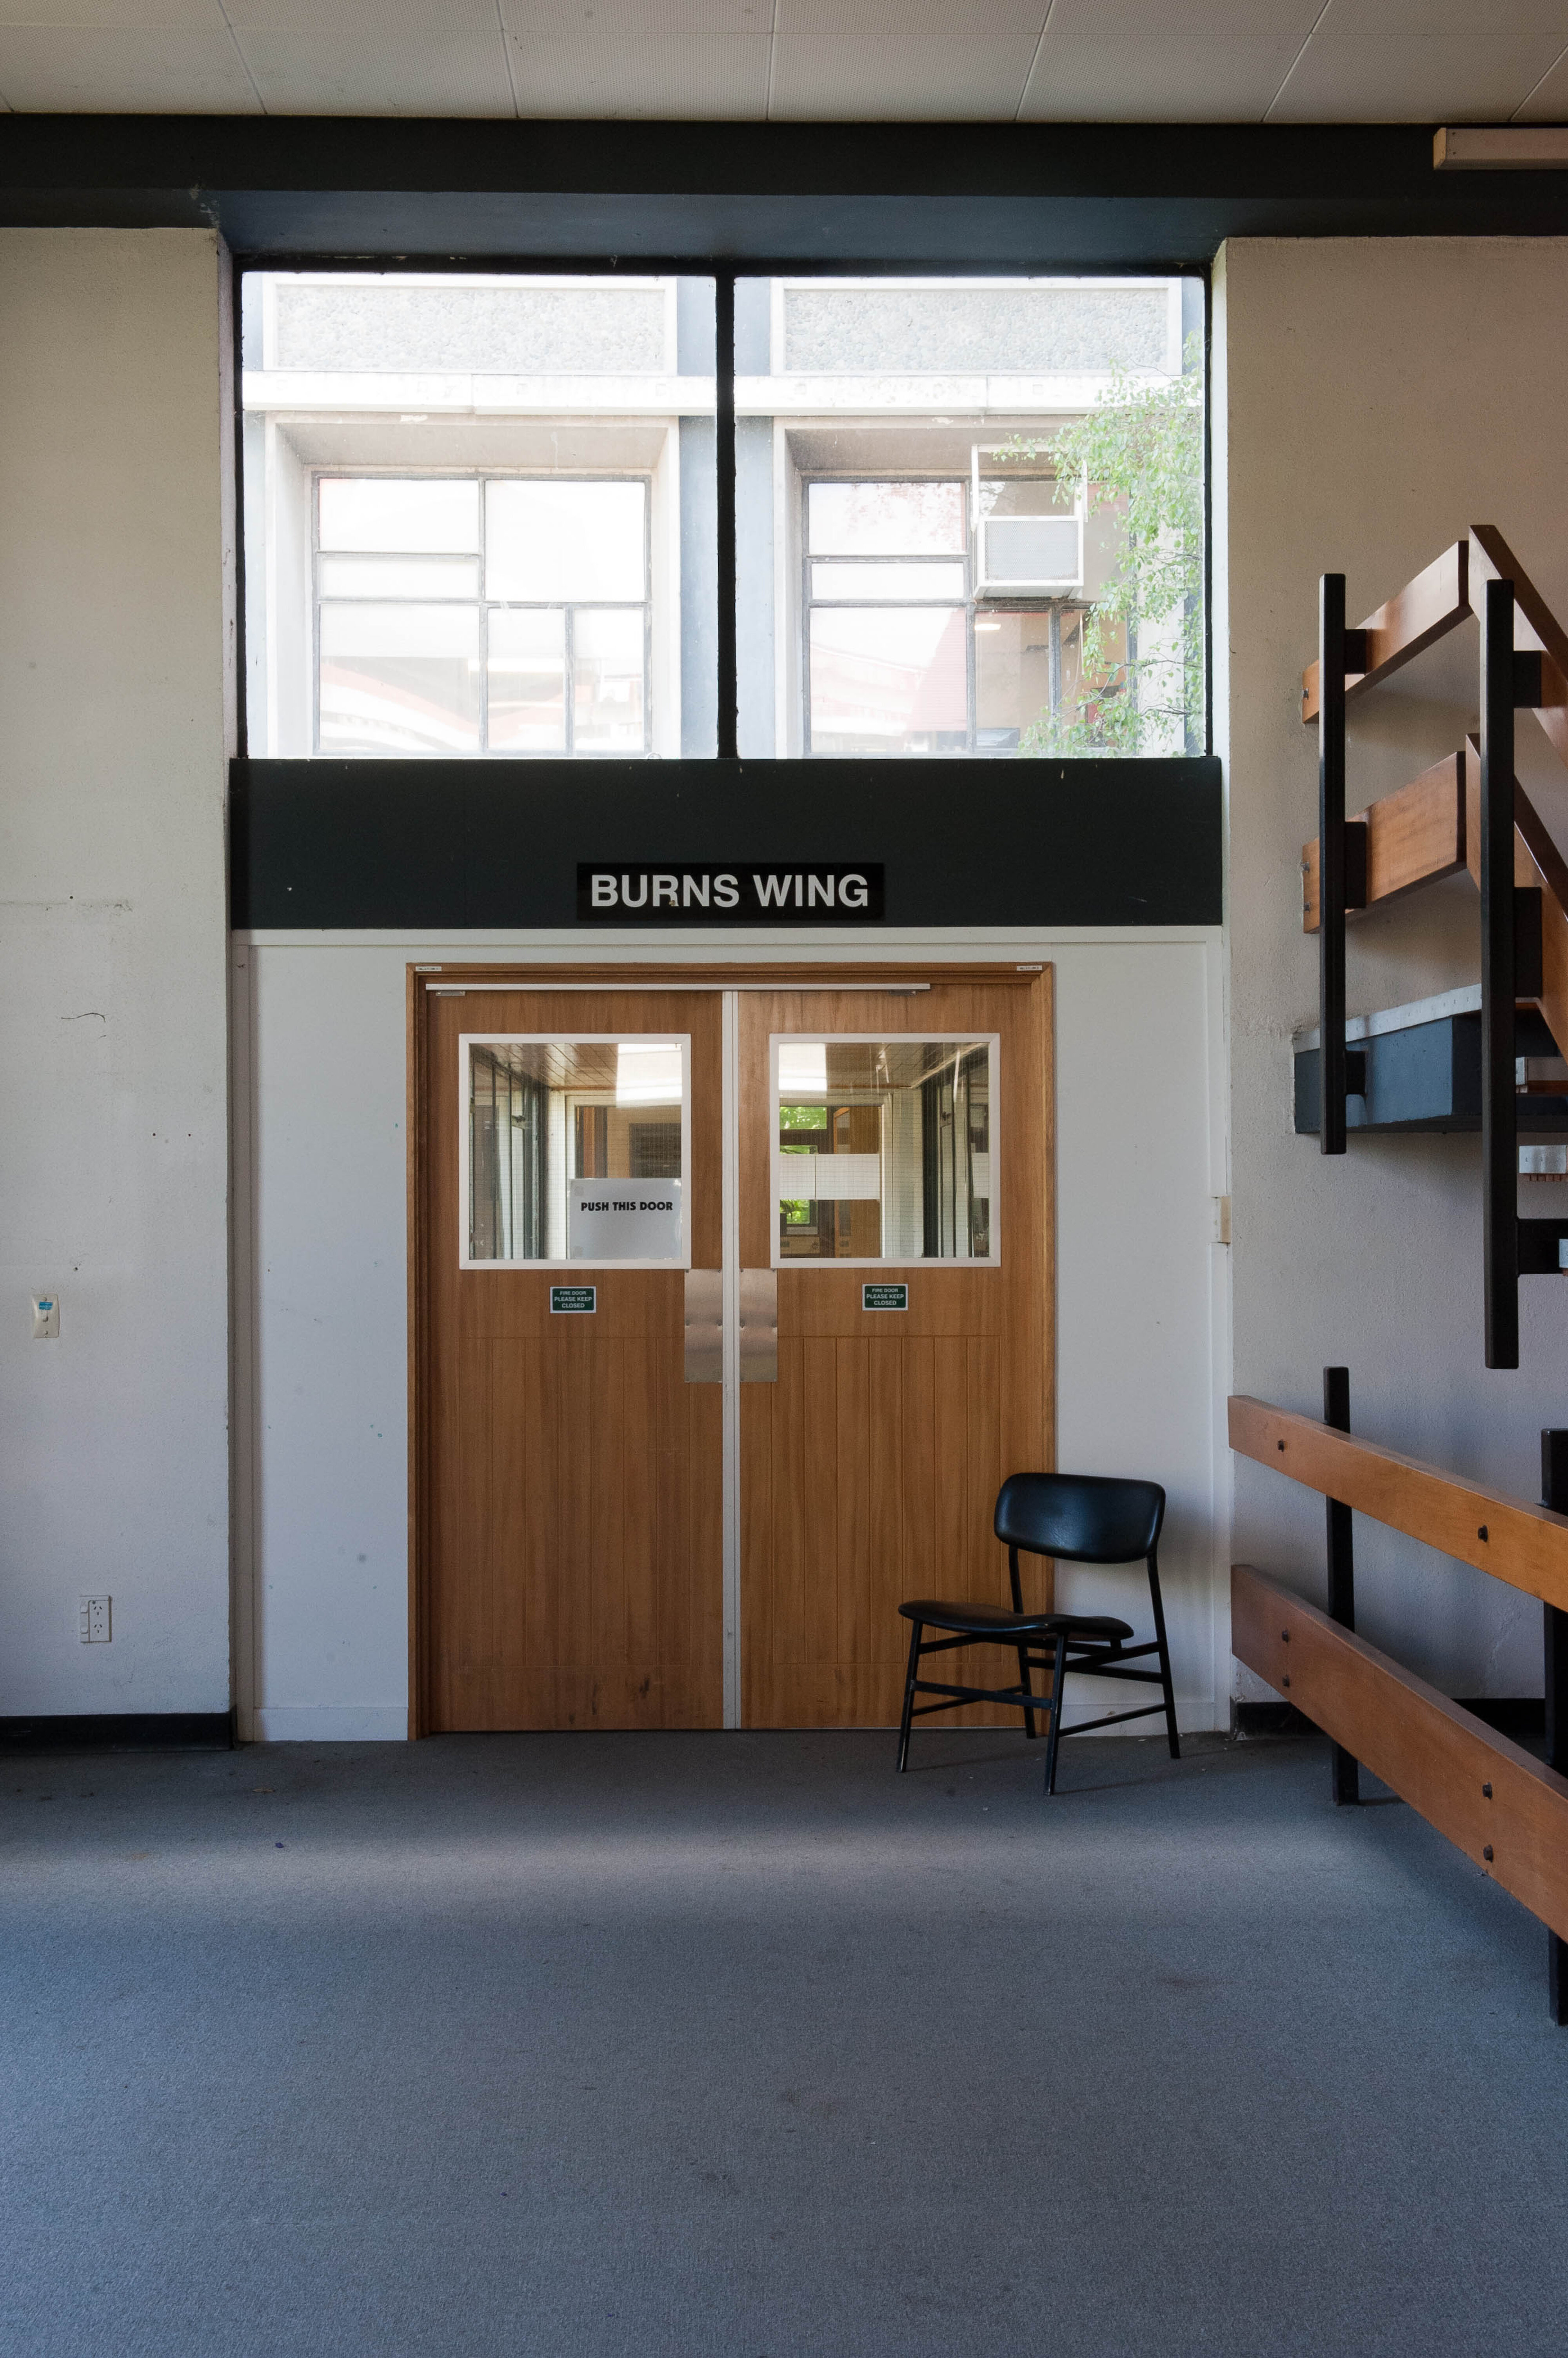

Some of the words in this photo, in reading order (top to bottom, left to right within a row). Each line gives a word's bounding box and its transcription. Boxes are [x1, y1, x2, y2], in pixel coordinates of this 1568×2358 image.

[591, 874, 739, 908] BURNS
[753, 874, 869, 907] WING
[581, 1201, 609, 1211] PUSH
[612, 1201, 636, 1211] THIS
[640, 1201, 673, 1211] DOOR
